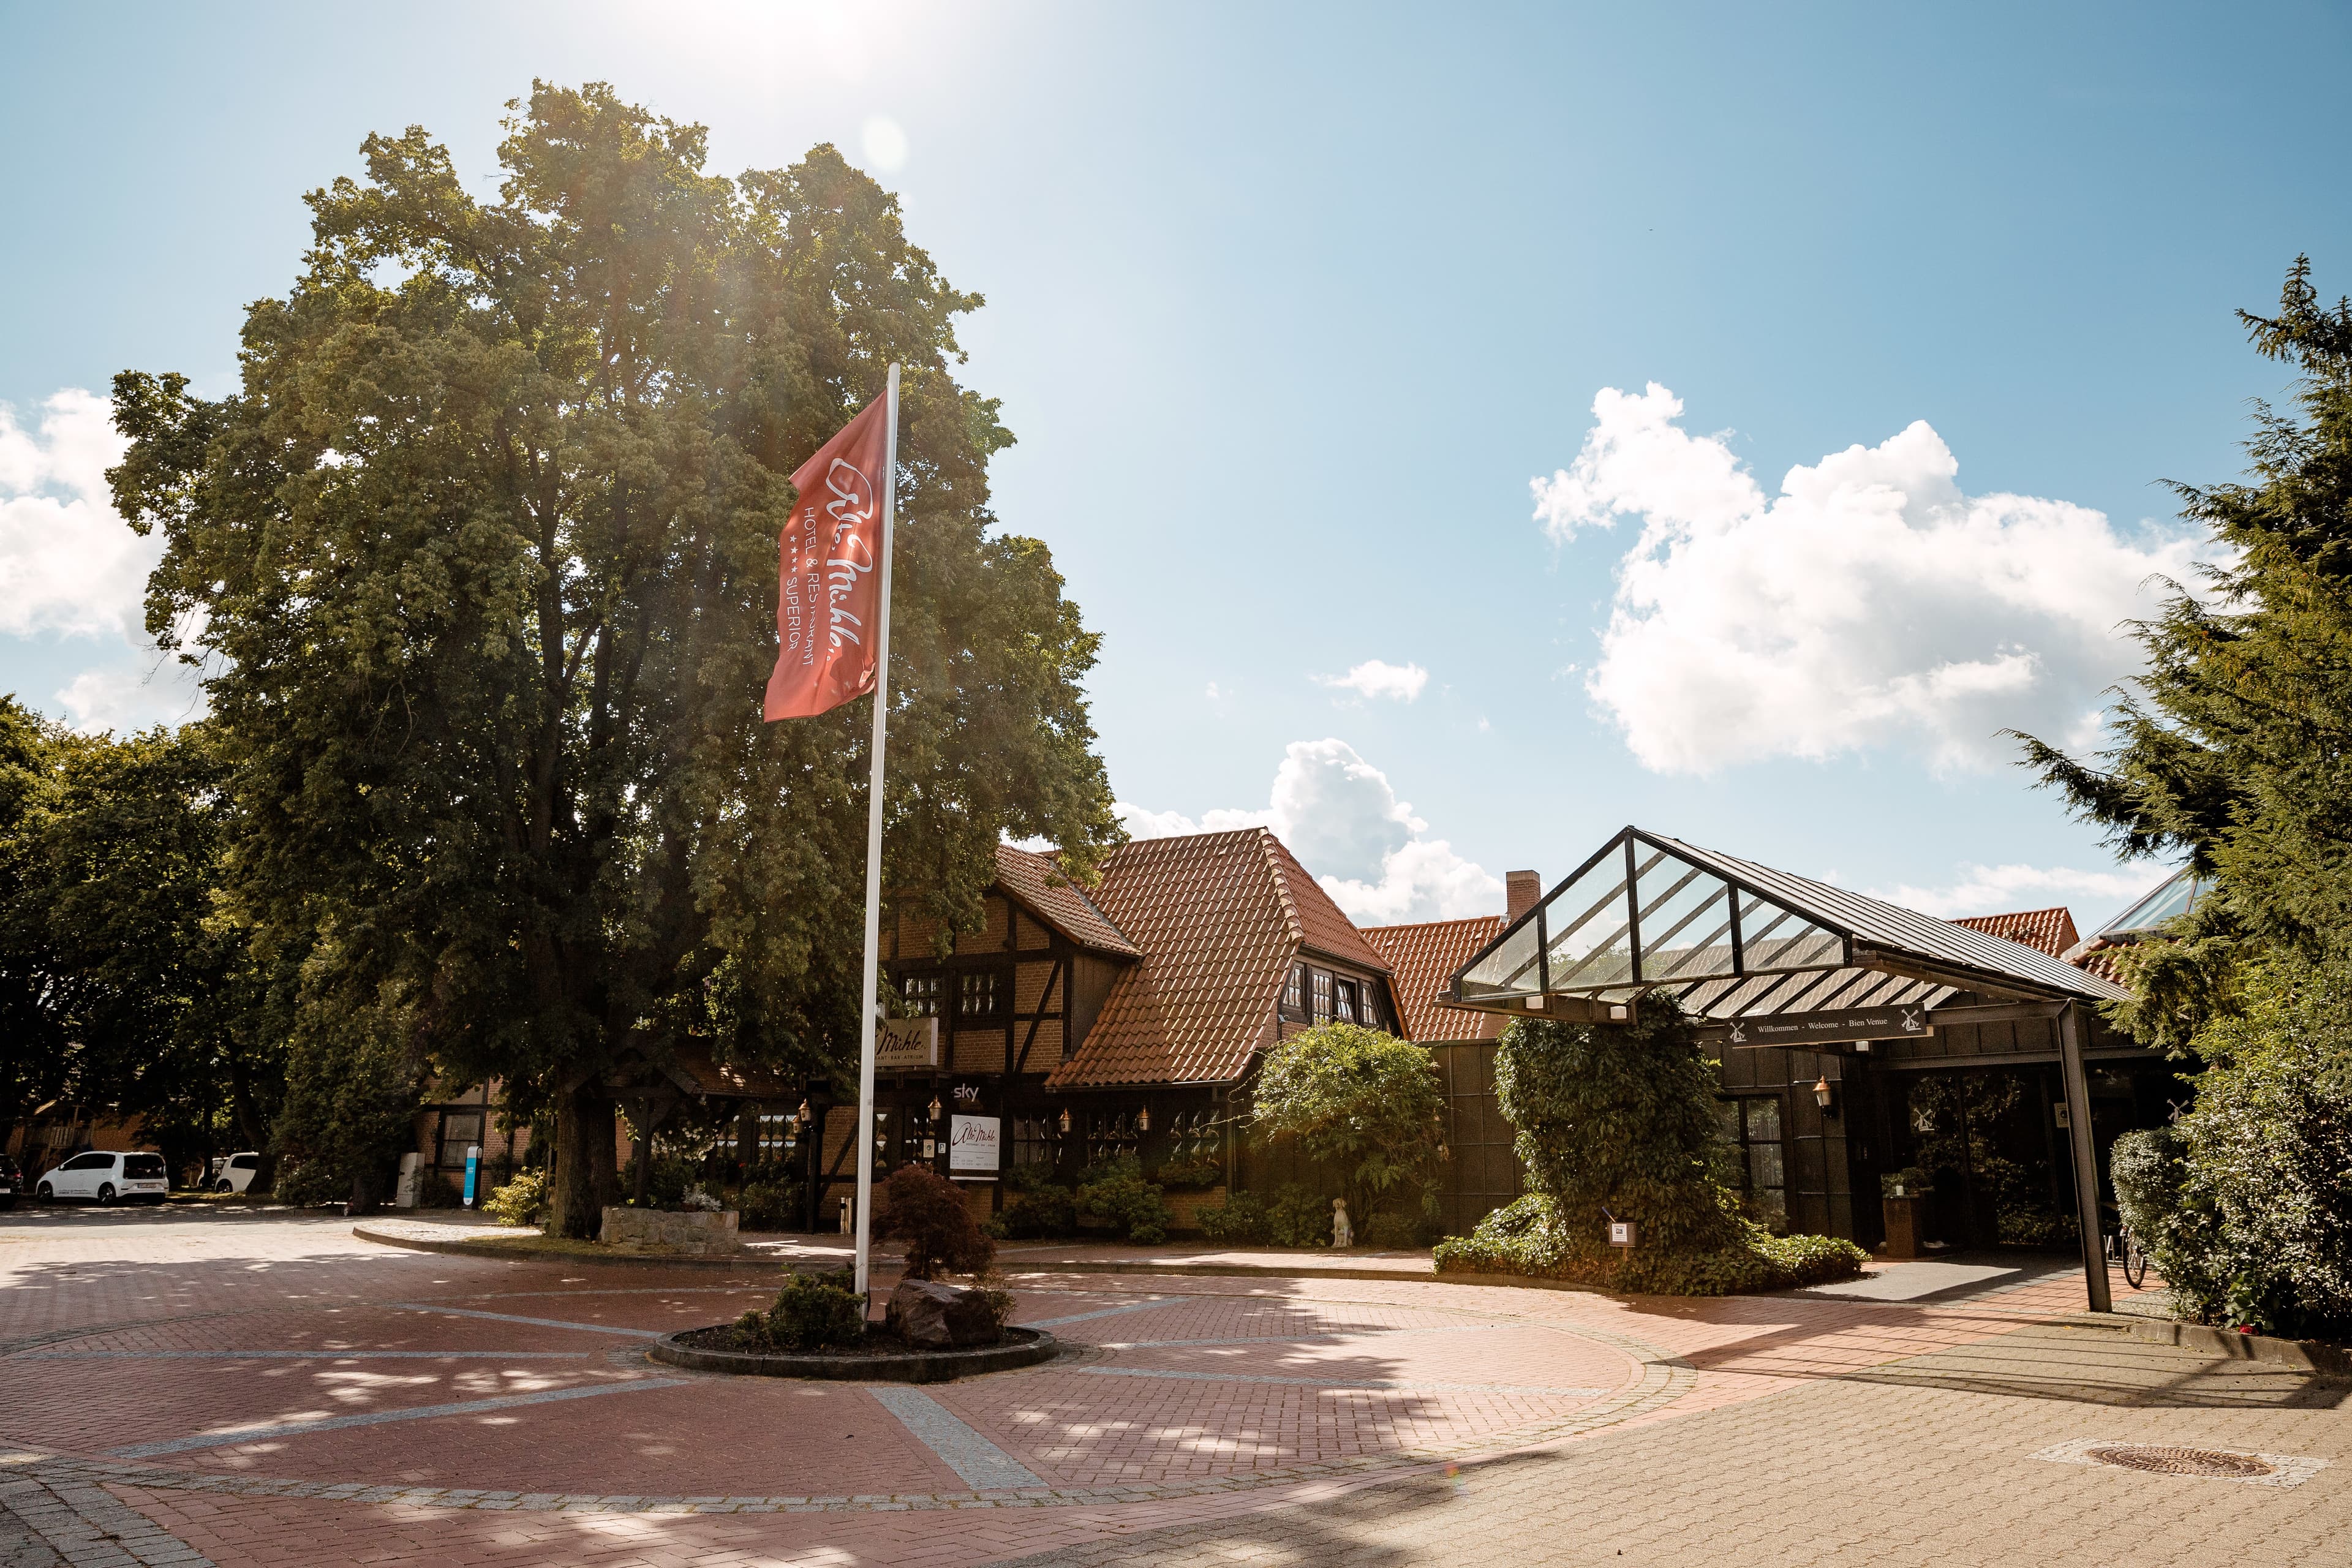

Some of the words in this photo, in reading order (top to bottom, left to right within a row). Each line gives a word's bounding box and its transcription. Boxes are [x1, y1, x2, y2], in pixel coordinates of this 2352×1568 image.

[804, 507, 816, 555] HOTEL
[805, 558, 818, 568] &
[786, 577, 801, 652] SUPERIOR
[954, 1083, 979, 1102] sky
[952, 1121, 975, 1146] Alte
